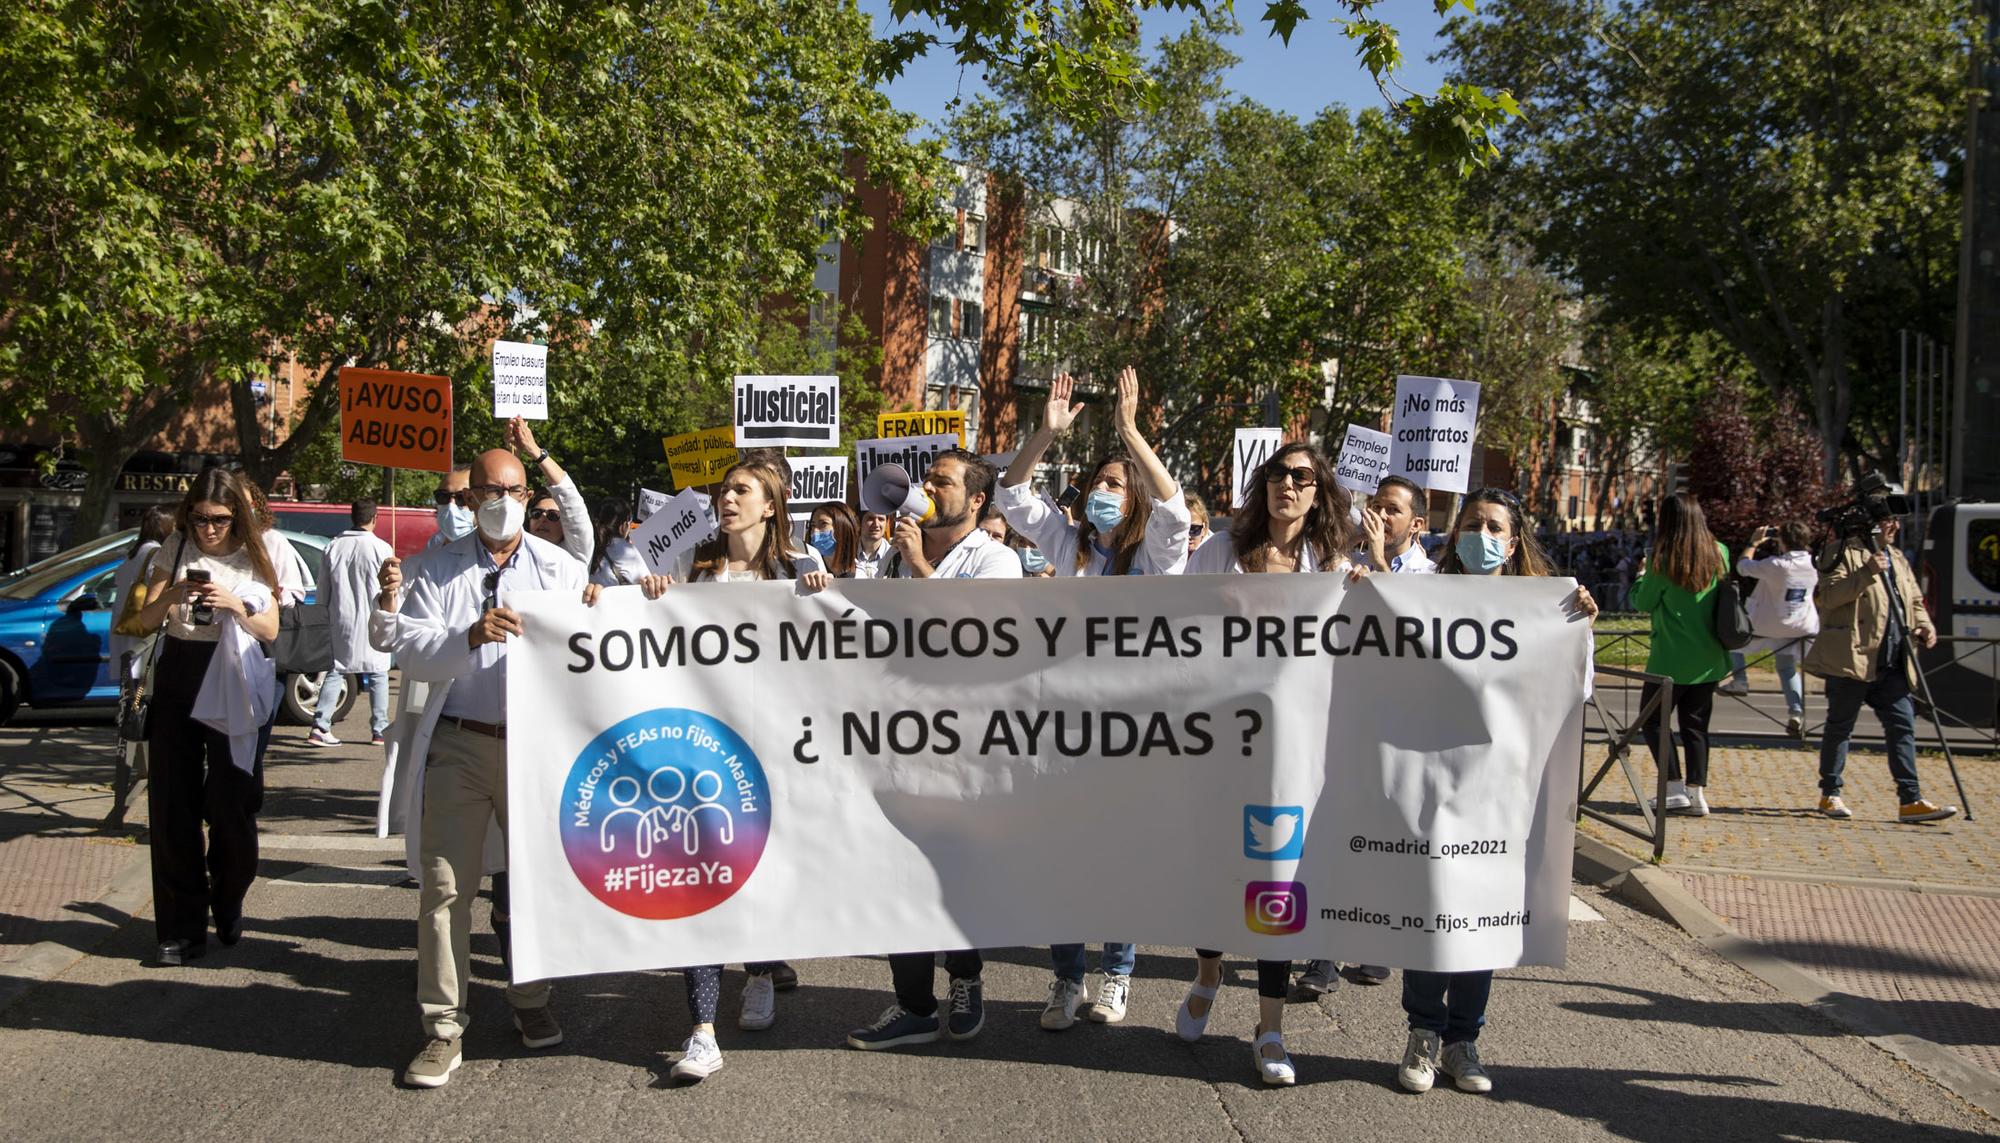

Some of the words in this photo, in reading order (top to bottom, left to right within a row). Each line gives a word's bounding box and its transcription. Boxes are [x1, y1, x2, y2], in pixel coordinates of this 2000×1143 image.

[521, 353, 545, 369] basura
[347, 382, 449, 420] ¡AYUSO,
[737, 384, 836, 427] ¡Justicia!
[1403, 393, 1430, 418] ¡No
[1435, 393, 1466, 413] más
[348, 419, 449, 453] ABUSO!
[1346, 434, 1388, 455] Empleo
[1398, 426, 1469, 443] contratos
[701, 459, 707, 476] y
[1340, 451, 1349, 463] y
[1349, 454, 1377, 468] poco
[1405, 453, 1460, 472] basura!
[1337, 465, 1372, 483] dañan
[648, 533, 672, 567] ¡No
[671, 509, 697, 540] más
[567, 621, 761, 673] SOMOS
[779, 608, 1020, 662] MÉDICOS
[1034, 616, 1067, 657] Y
[1086, 616, 1202, 657] FEAs
[1223, 613, 1519, 662] PRECARIOS
[793, 716, 819, 764] ¿
[842, 709, 961, 755] NOS
[979, 709, 1214, 757] AYUDAS
[1235, 708, 1263, 757] ?
[574, 758, 610, 828] Médicos
[606, 748, 618, 765] y
[616, 726, 658, 754] FEAs
[661, 725, 683, 739] no
[686, 724, 721, 753] fijos
[724, 754, 758, 813] Madrid
[1349, 835, 1508, 860] @madrid_ope2021
[604, 861, 733, 893] #FijezaYa
[1320, 907, 1531, 933] medicos_no_fijos_madrid
